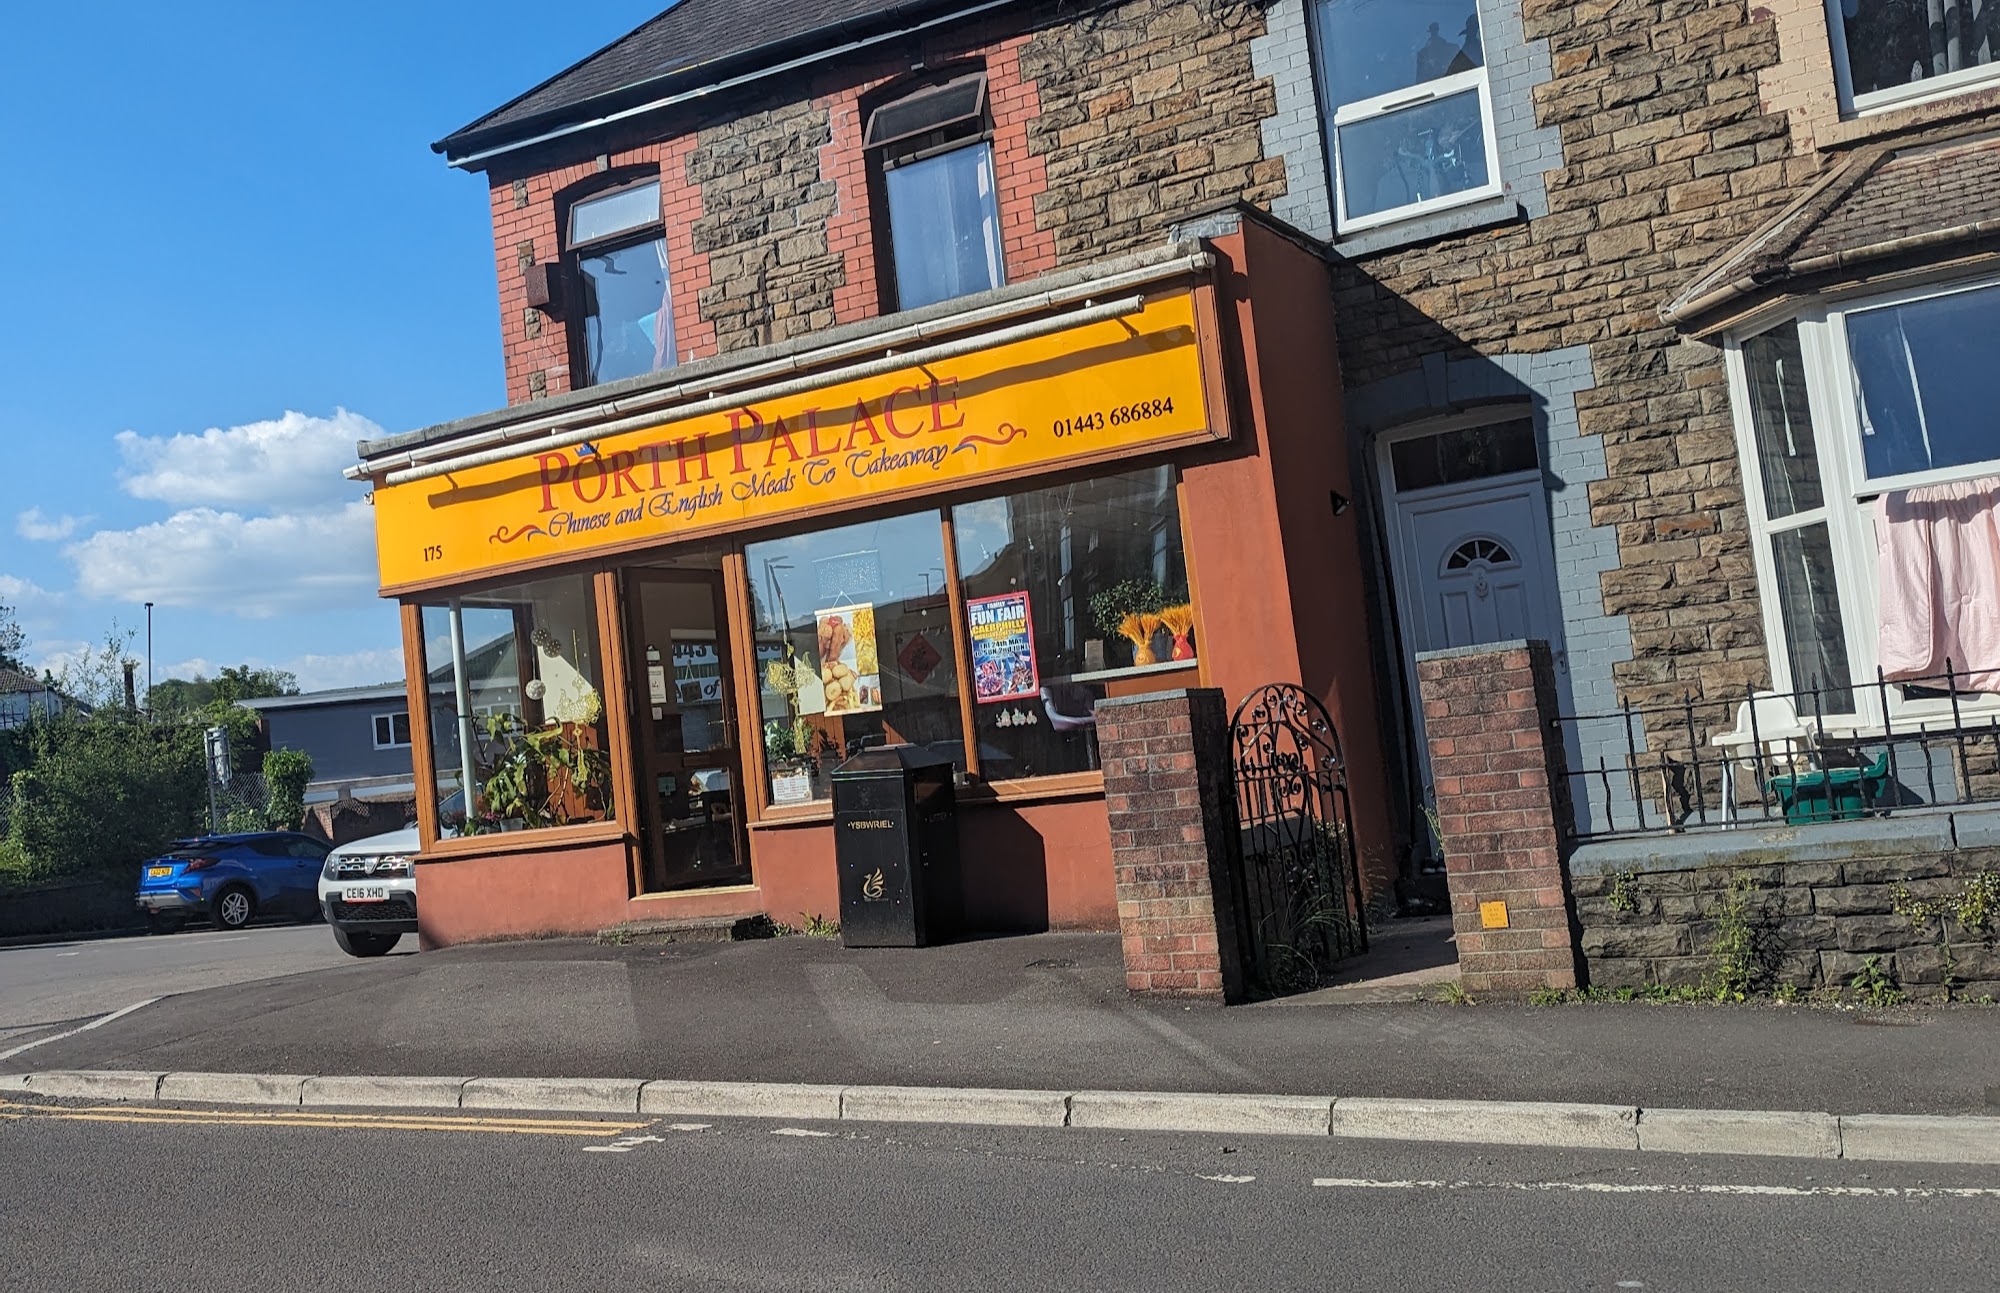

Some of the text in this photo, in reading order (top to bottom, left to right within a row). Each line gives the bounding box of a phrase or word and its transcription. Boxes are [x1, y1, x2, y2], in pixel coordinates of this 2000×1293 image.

[1053, 396, 1174, 437] 01443 686884
[533, 376, 965, 513] PORTH PALACE
[549, 444, 949, 537] Chinese and English Meals To Takeaway
[423, 545, 443, 562] 175
[987, 601, 1005, 609] FAMILY
[970, 609, 995, 625] FUN
[997, 605, 1025, 621] FAIR
[972, 619, 1026, 634] CAERPHILLY
[983, 647, 997, 655] SUN
[850, 820, 892, 829] YSBWRIEL
[346, 887, 384, 898] CE16 XHD
